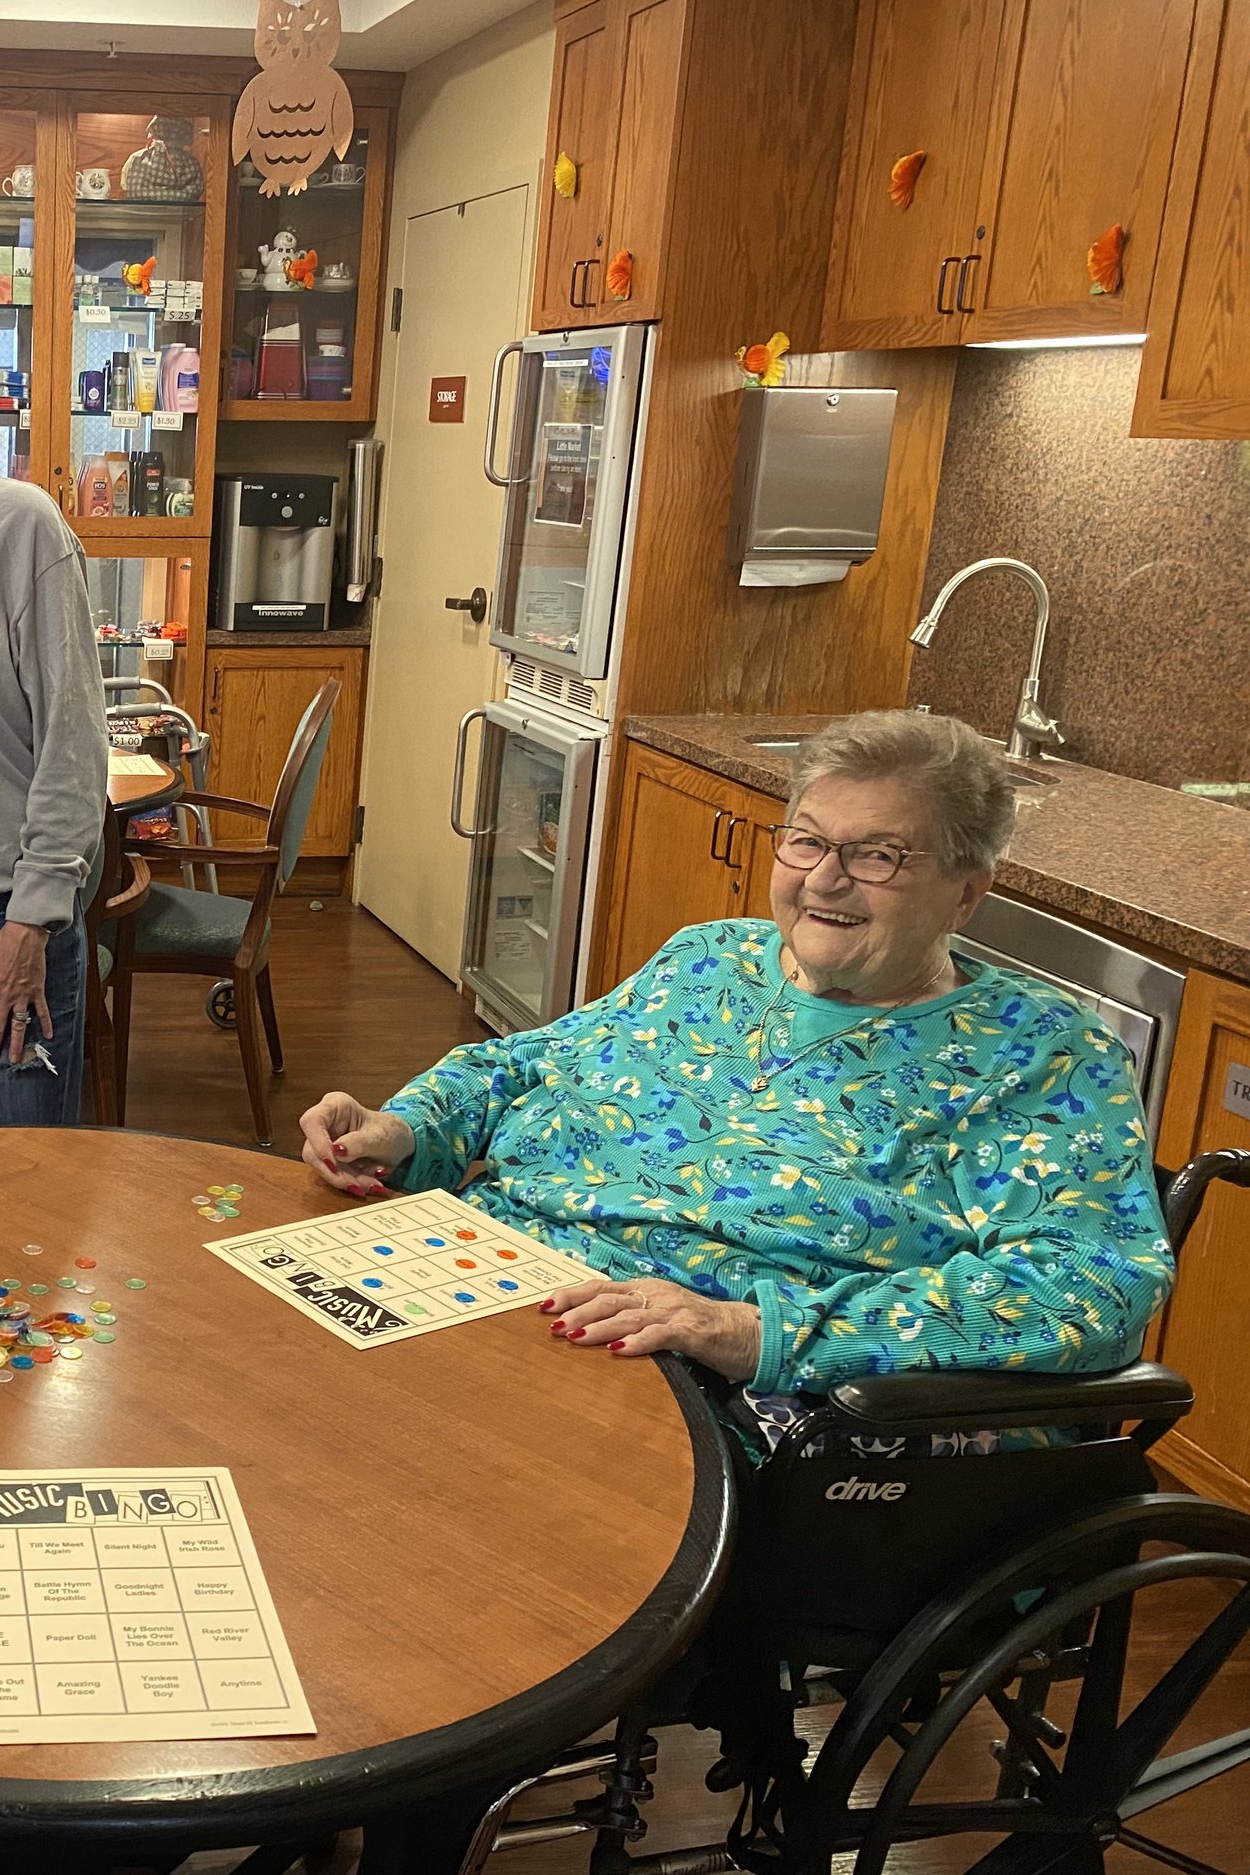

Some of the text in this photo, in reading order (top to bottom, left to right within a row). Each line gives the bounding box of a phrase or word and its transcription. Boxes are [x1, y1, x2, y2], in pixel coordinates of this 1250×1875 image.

[169, 311, 190, 320] $.25
[113, 736, 140, 746] $1.00
[263, 1246, 335, 1289] BINGO
[825, 1476, 907, 1500] drive
[74, 1493, 198, 1520] BINGO
[57, 1681, 101, 1689] Amazing
[153, 1690, 174, 1698] Boy
